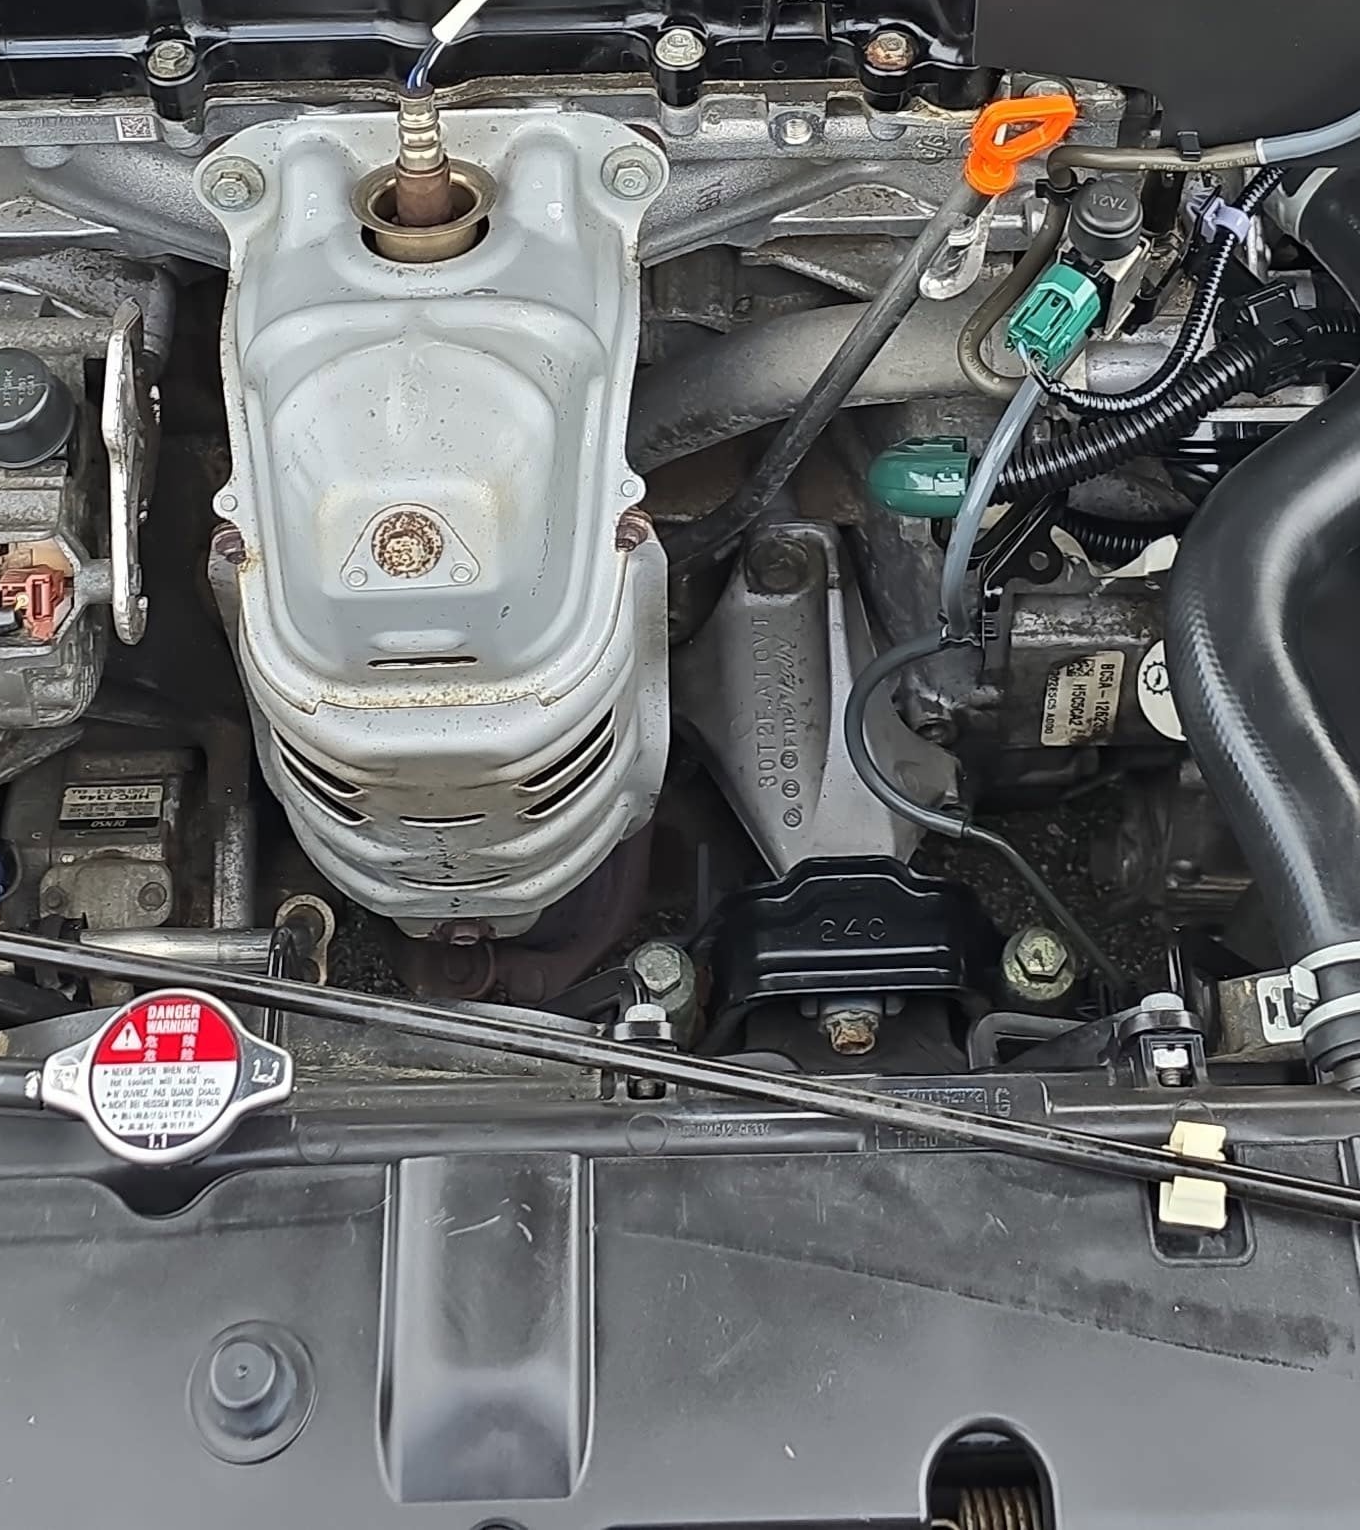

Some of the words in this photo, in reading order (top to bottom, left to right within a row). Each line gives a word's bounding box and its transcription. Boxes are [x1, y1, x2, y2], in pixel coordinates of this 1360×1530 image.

[147, 1004, 201, 1020] DANGER
[146, 1019, 199, 1034] WARNING
[112, 1068, 132, 1076] NEVER
[138, 1067, 156, 1075] OPEN
[153, 1088, 166, 1096] PAS
[108, 1100, 127, 1109] NICHT
[172, 1099, 192, 1107] MOTOR
[148, 1133, 168, 1149] 1.1
